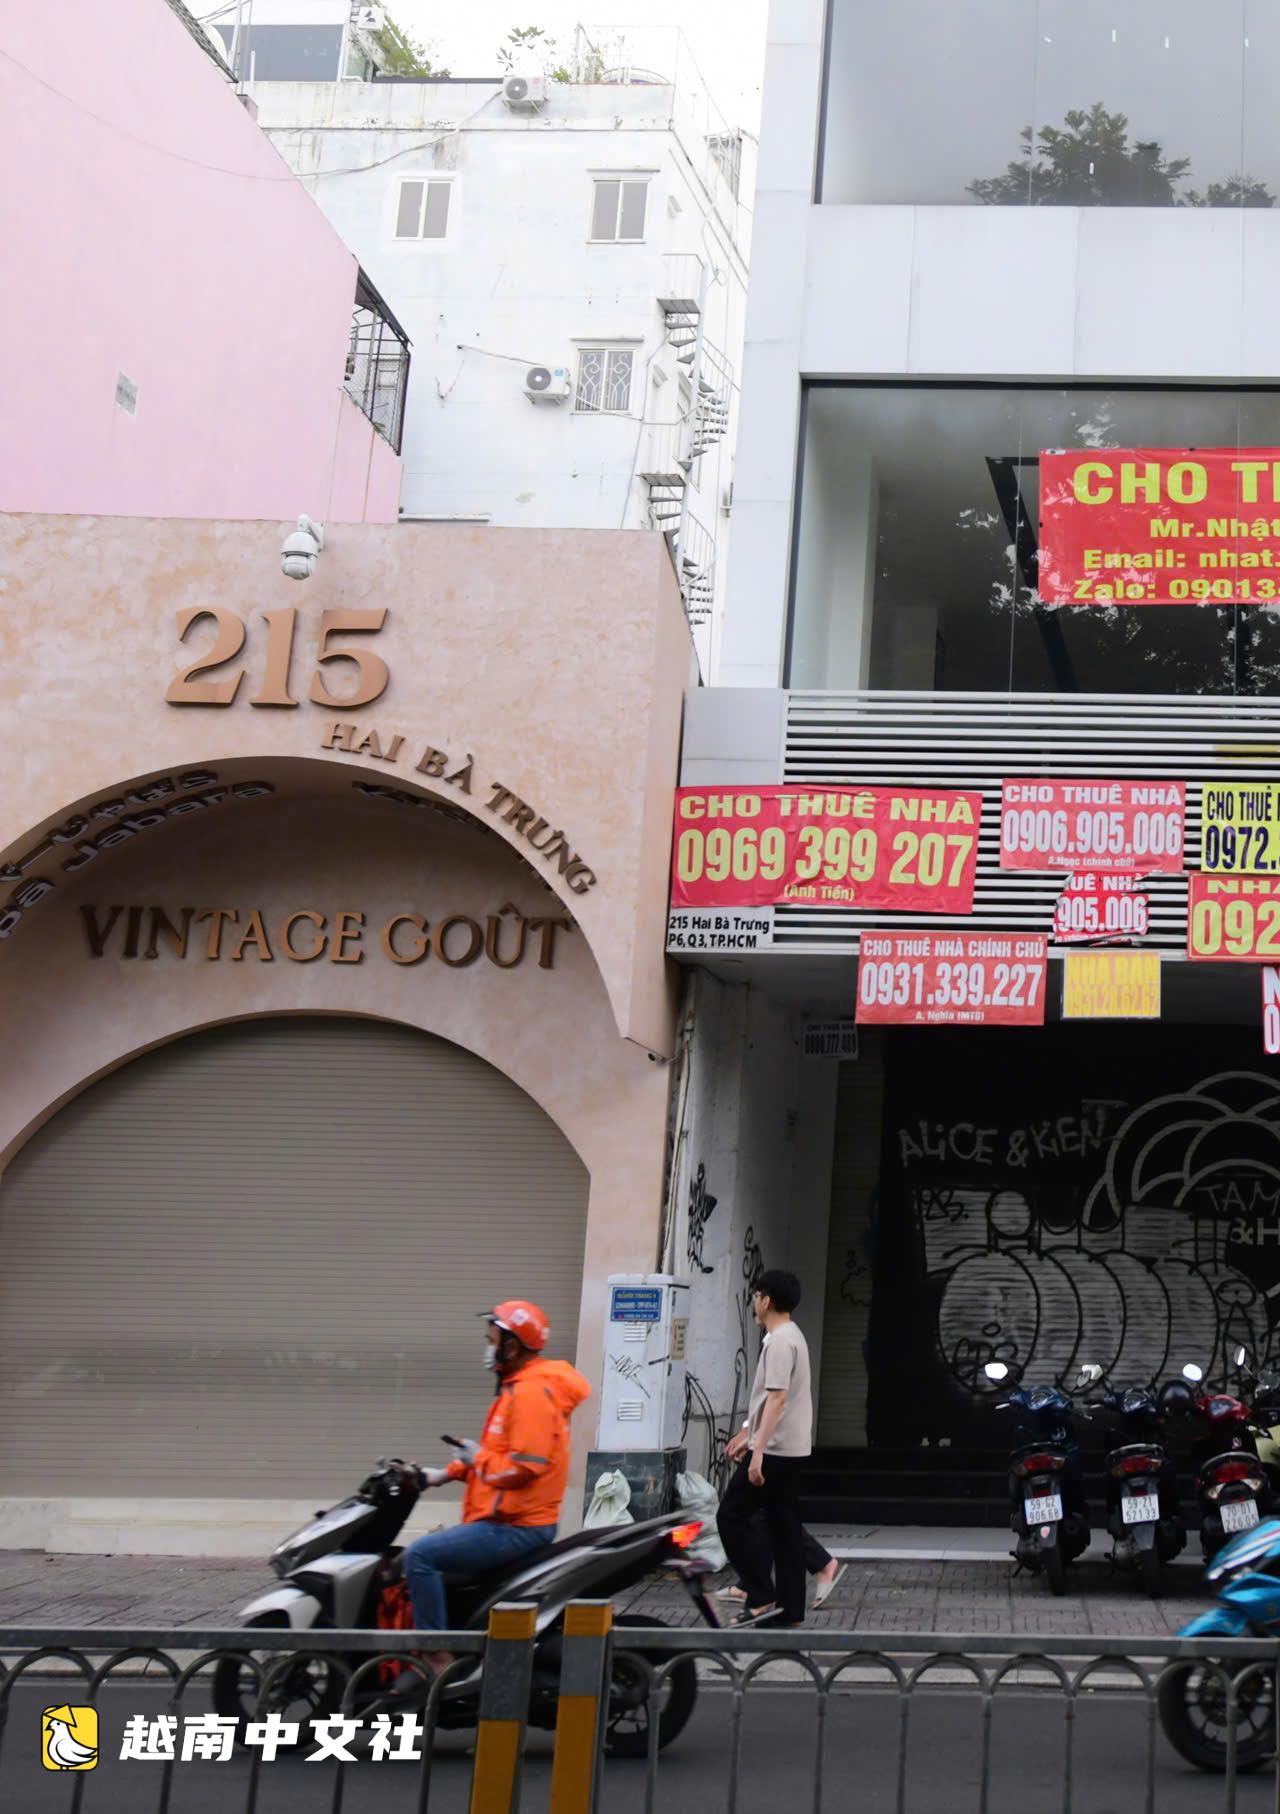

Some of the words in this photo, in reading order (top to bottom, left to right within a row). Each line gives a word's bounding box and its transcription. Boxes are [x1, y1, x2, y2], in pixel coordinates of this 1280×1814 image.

[1073, 462, 1208, 505] CHO
[1084, 548, 1185, 569] Email:
[1075, 579, 1156, 600] Zalo:
[165, 607, 390, 708] 215
[321, 723, 405, 762] HAI
[416, 746, 473, 795] BÀ
[485, 782, 597, 895] TRƯNG
[680, 795, 761, 819] CHO
[774, 791, 876, 818] THUÊ
[889, 796, 974, 824] NHÀ
[1005, 785, 1053, 803] CHO
[1061, 784, 1122, 804] THUÊ
[1131, 785, 1182, 805] NHÀ
[1207, 791, 1234, 821] CHO
[1239, 785, 1272, 821] THUÊ
[1003, 809, 1182, 856] 0906.905.006
[678, 827, 786, 882] 0969
[796, 826, 877, 881] 399
[889, 831, 974, 887] 207
[784, 884, 816, 899] (Anh
[1066, 873, 1096, 891] UÊ
[80, 903, 365, 964] VINTAGE
[381, 902, 579, 969] GOÛT
[669, 916, 688, 929] 215
[692, 917, 711, 929] Hai
[715, 916, 729, 929] Bà
[734, 917, 769, 934] Trưng
[863, 940, 892, 956] CHO
[896, 938, 930, 956] THUÊ
[935, 937, 964, 956] NHÀ
[968, 938, 1011, 957] CHÍNH
[1016, 936, 1044, 957] CHỦ
[861, 962, 1043, 1007] 0931.339.227
